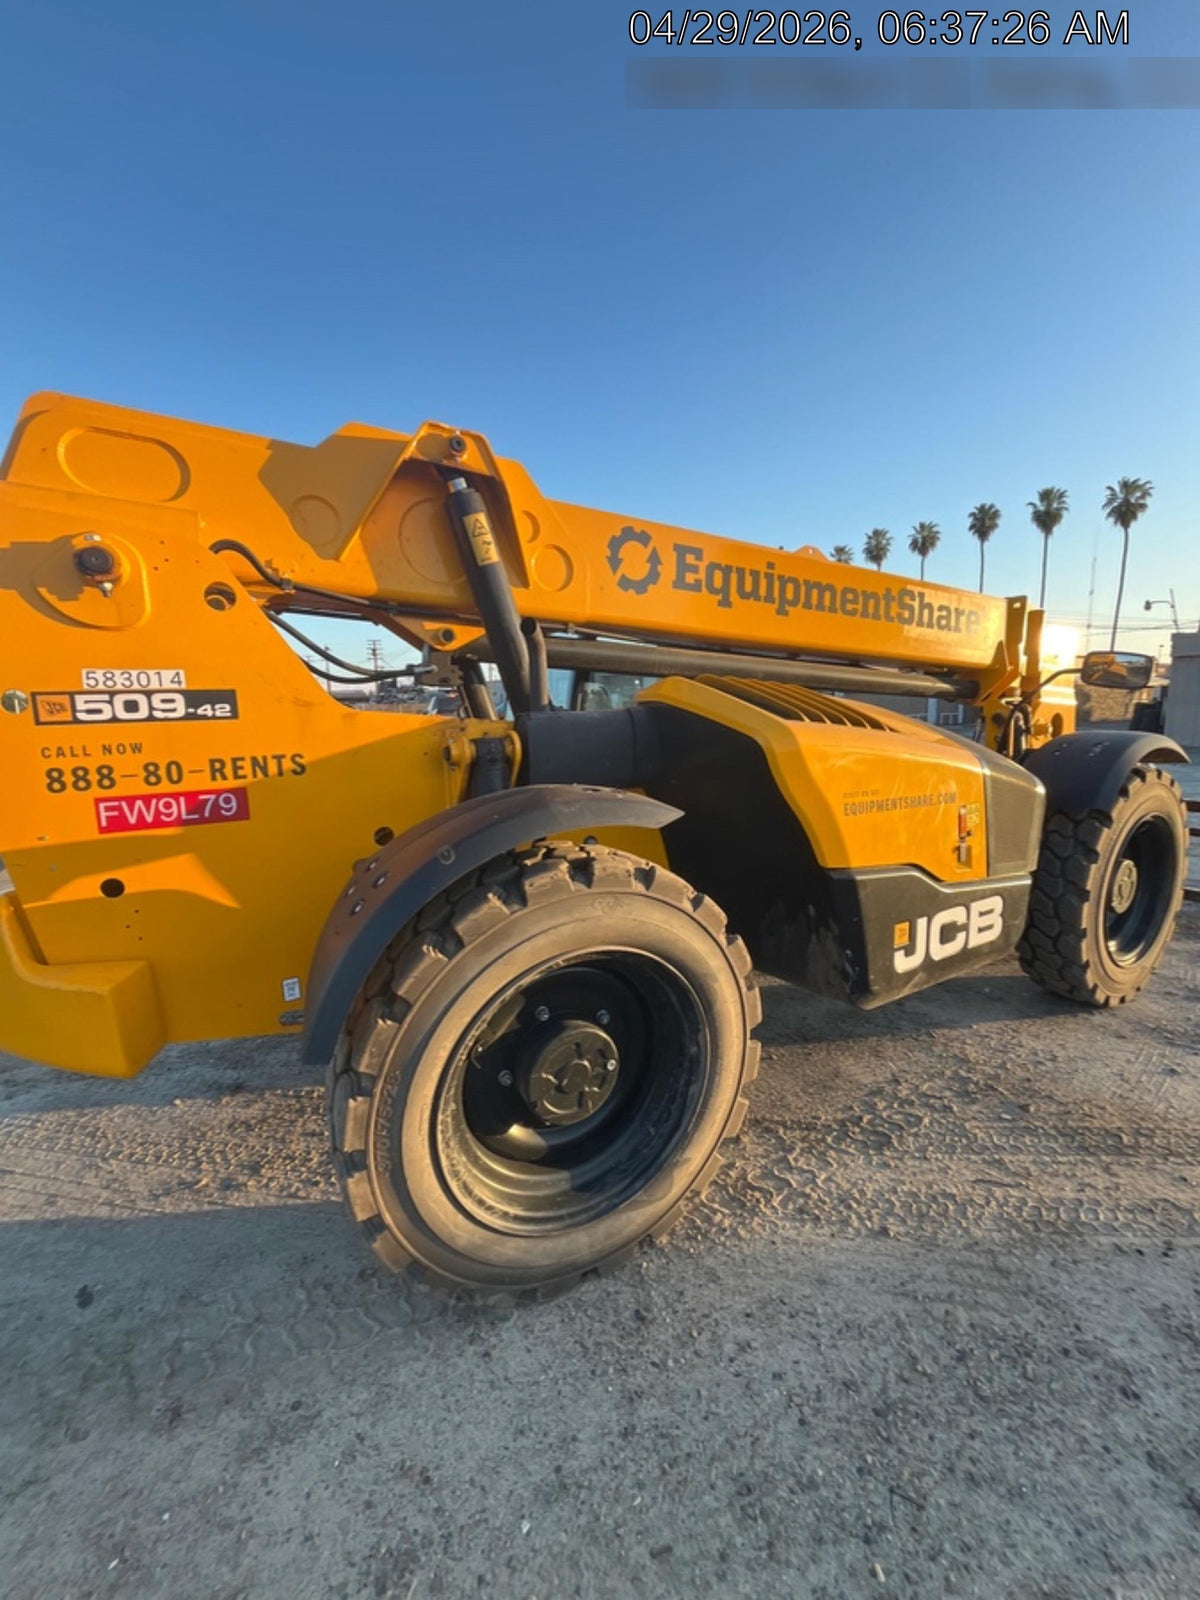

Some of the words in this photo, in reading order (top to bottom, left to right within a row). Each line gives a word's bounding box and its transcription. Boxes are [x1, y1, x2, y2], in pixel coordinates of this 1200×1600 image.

[672, 543, 981, 635] EquipmentShare
[84, 671, 184, 689] 583014
[74, 692, 232, 721] 509-42
[41, 746, 92, 760] CALL
[102, 742, 144, 756] NOW
[98, 792, 238, 828] FW9L79
[844, 792, 956, 817] EQUIPMENTSHARE.COM
[893, 895, 1004, 974] JCB
